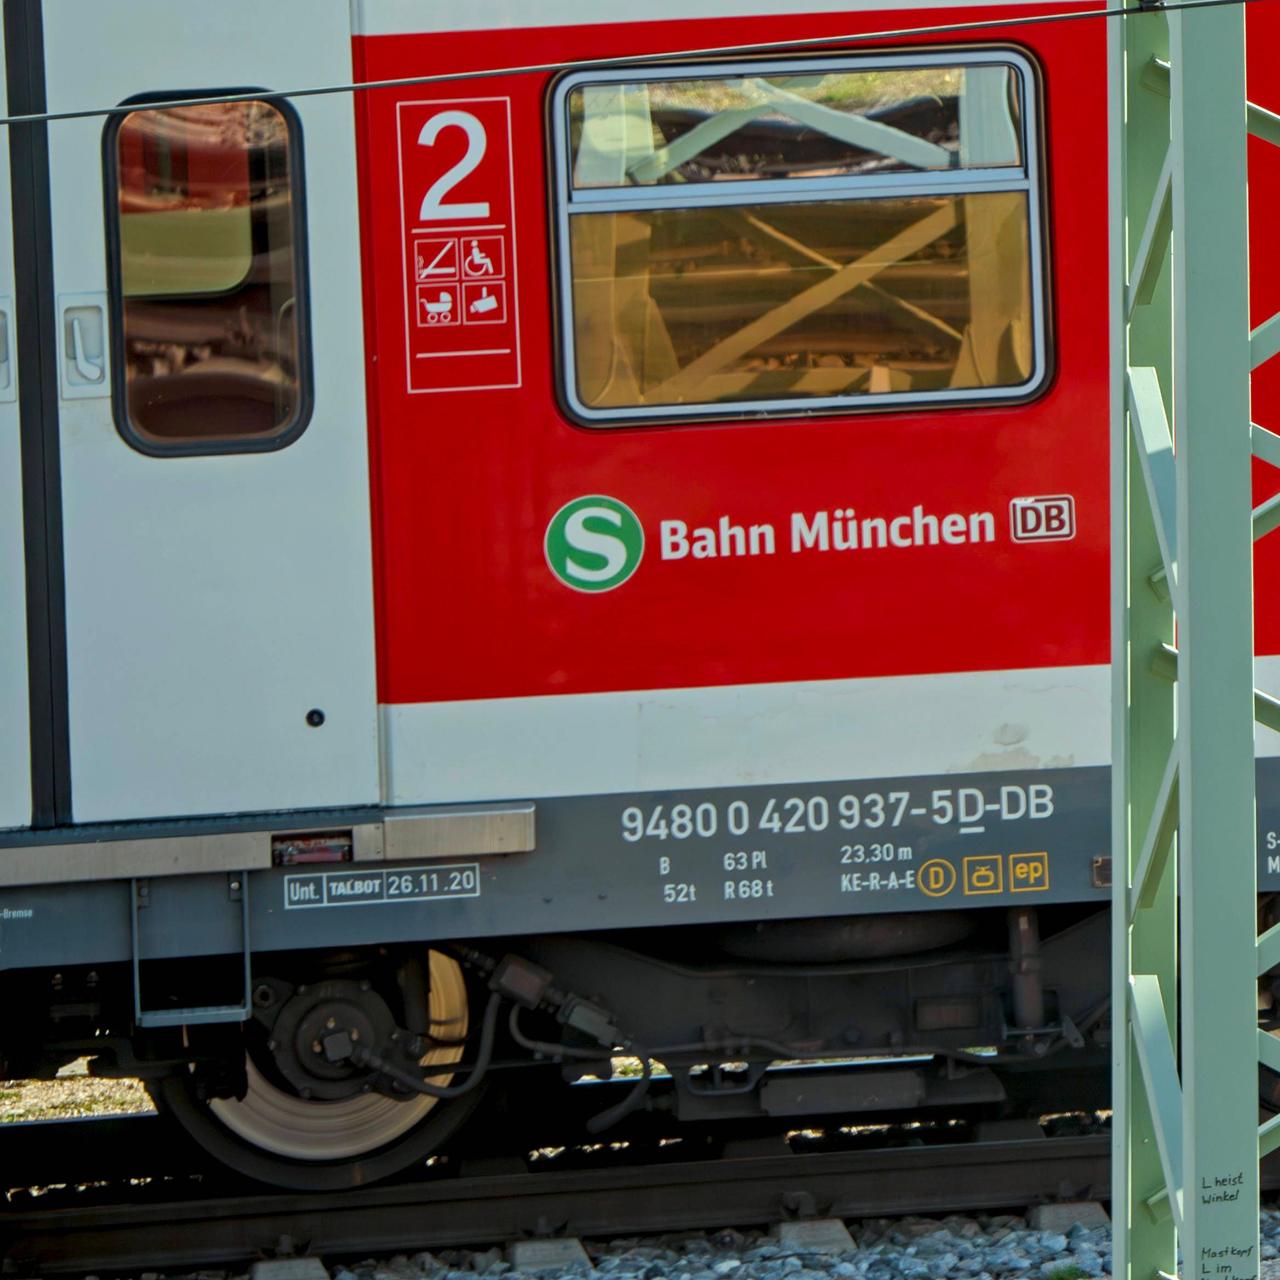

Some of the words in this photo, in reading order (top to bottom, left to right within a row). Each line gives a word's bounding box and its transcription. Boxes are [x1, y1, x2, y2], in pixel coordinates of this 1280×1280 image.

[416, 110, 491, 221] 2
[564, 506, 628, 582] S
[660, 515, 776, 561] Bahn
[790, 503, 996, 554] München
[1021, 504, 1068, 535] DB
[621, 802, 718, 842] 9480
[727, 800, 750, 836] 0
[758, 795, 830, 834] 420
[723, 852, 748, 871] 63
[897, 846, 913, 861] m
[659, 856, 671, 875] B
[1015, 862, 1043, 885] ep
[840, 870, 915, 892] KE-R-A-E
[929, 867, 944, 889] D
[289, 881, 320, 901] Unt.
[328, 879, 382, 896] TALBOT
[724, 881, 736, 900] R
[739, 880, 763, 898] 68
